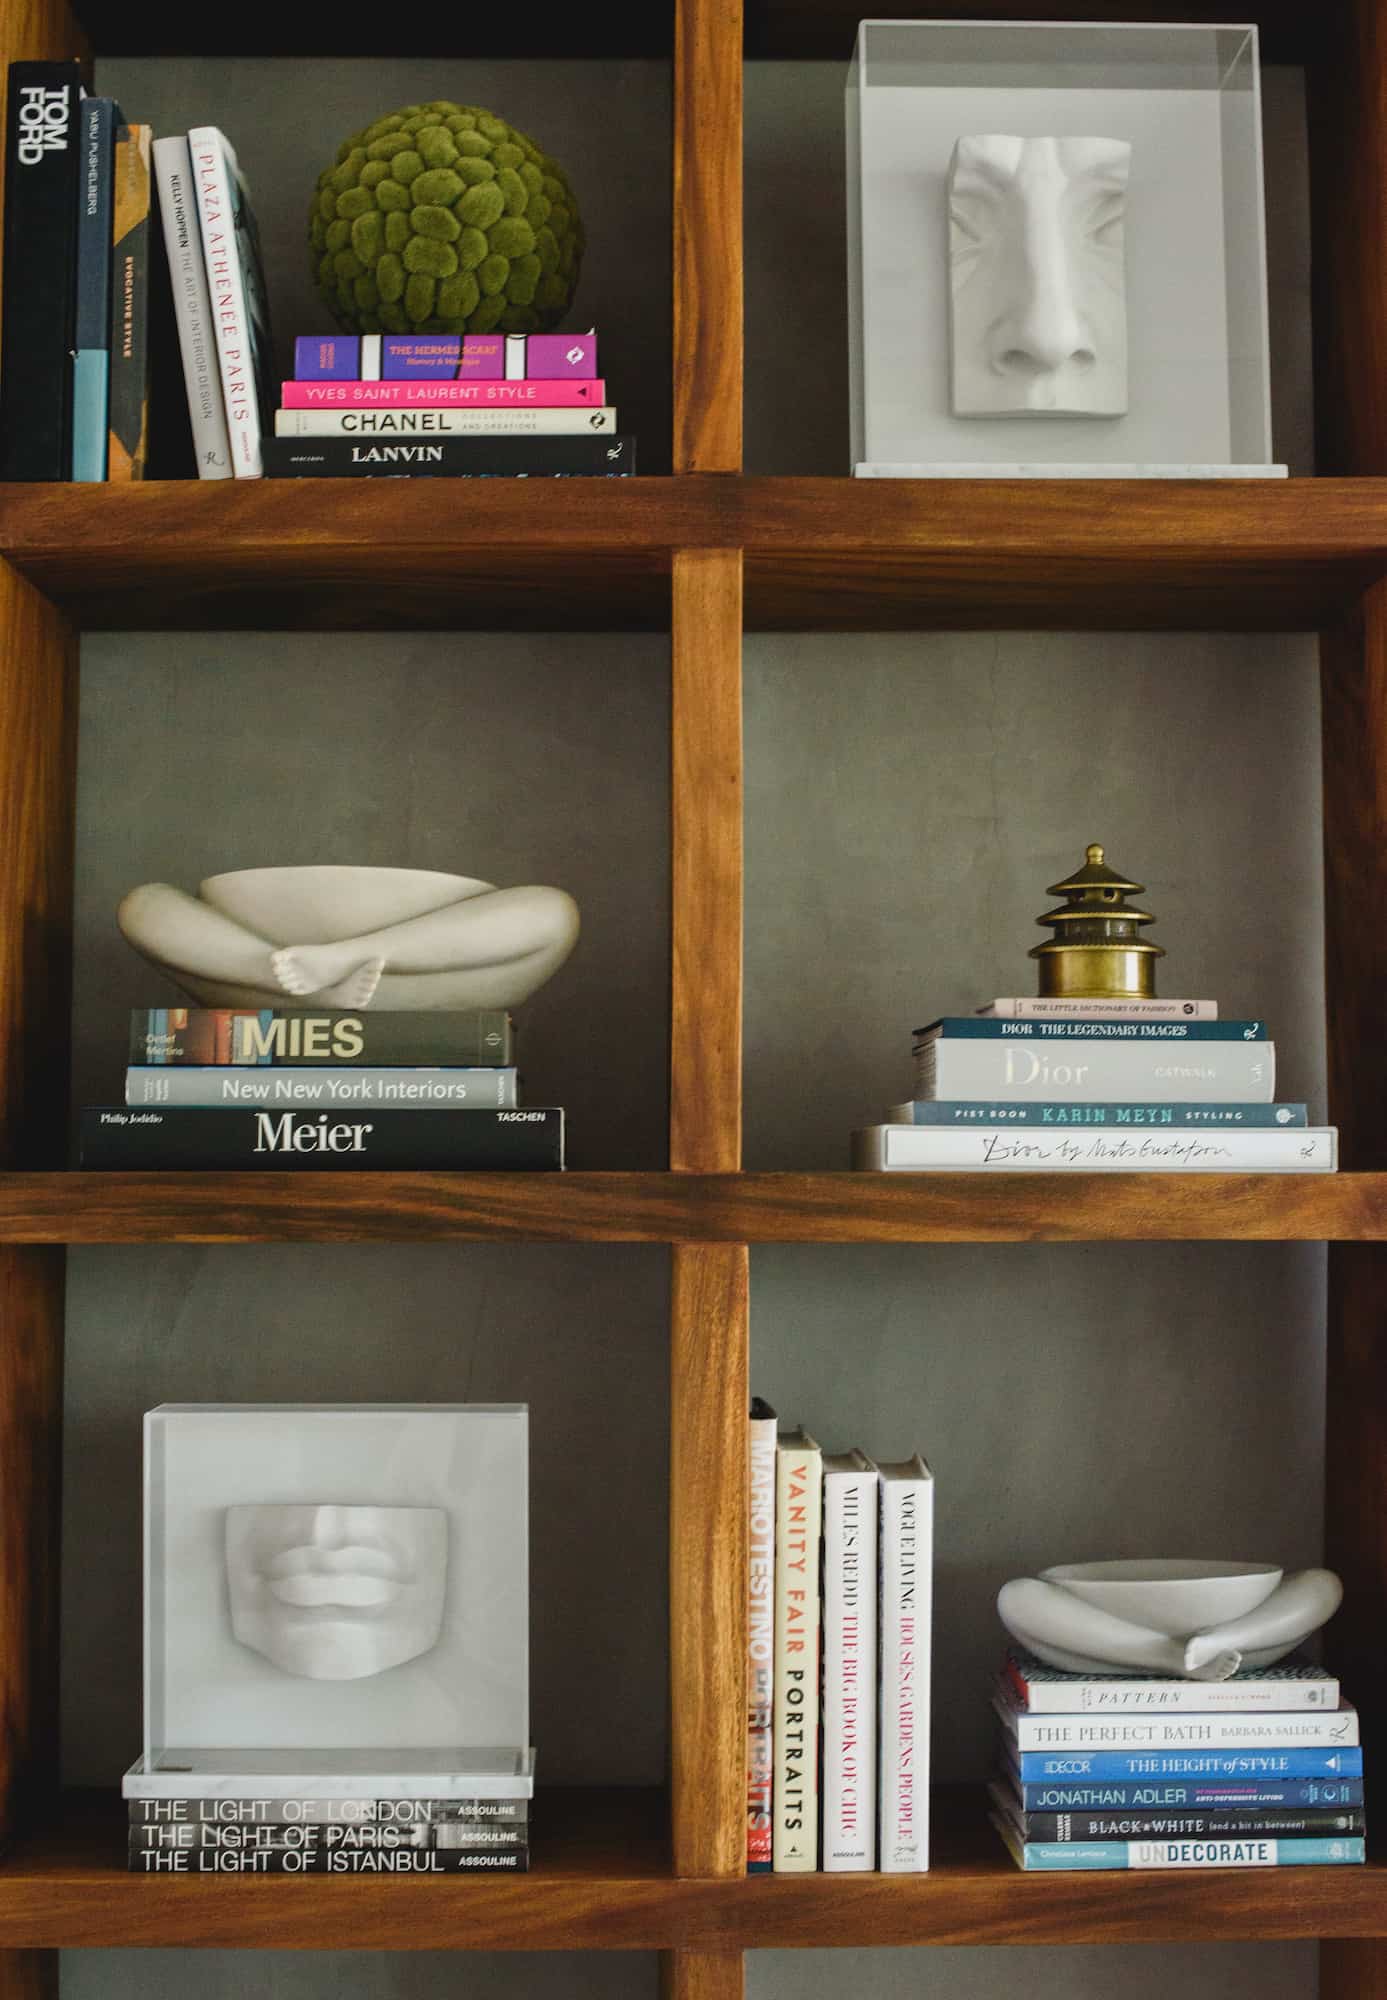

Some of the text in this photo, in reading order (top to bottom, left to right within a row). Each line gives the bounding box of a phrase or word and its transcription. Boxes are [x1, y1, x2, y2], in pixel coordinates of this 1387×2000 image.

[18, 86, 46, 165] FORD
[44, 84, 70, 151] TOM
[87, 109, 100, 216] YABU PUSHELBERG
[170, 174, 184, 204] KELLY
[175, 206, 190, 249] HOPPEN
[199, 153, 222, 223] PLAZA
[225, 348, 250, 422] PARIS
[122, 256, 134, 358] EVOCATIVE STYLE
[191, 317, 208, 376] INTERIOR
[389, 345, 412, 355] THE
[198, 375, 214, 420] DESIGN
[305, 387, 538, 400] YVES SAINT LAURENT STYLE
[341, 413, 453, 432] CHANEL
[352, 446, 444, 463] LANVIN
[243, 1017, 364, 1059] MIES
[1001, 1023, 1188, 1037] DIOR THE LEGENDARY IMAGES
[1004, 1047, 1089, 1085] Dior
[1153, 1065, 1216, 1079] CATWALK
[222, 1078, 467, 1099] New New York Interiors
[100, 1113, 129, 1125] Philip
[496, 1112, 546, 1122] TASCHEN
[955, 1108, 1244, 1123] PIET BOON KARIN MEYN STYLING
[253, 1112, 373, 1153] Meier
[983, 1135, 1052, 1163] Dior
[842, 1487, 859, 1546] MILES
[900, 1492, 916, 1548] VOGUE
[842, 1551, 858, 1607] REDD
[900, 1551, 915, 1609] LIVING
[747, 1439, 771, 1831] MARIO TESTINO PORTRAITS
[784, 1465, 806, 1830] VANITY FAIR PORTRAITS
[841, 1612, 858, 1654] THE
[841, 1659, 858, 1692] BIG
[1098, 1691, 1181, 1704] PATTERN
[841, 1697, 857, 1753] BOOK
[1034, 1725, 1321, 1742] THE PERFECT BATH BARBARA SALLICK
[841, 1756, 857, 1783] OF
[1127, 1759, 1159, 1773] THE
[1162, 1759, 1222, 1773] HEIGHT
[1223, 1758, 1239, 1774] of
[1240, 1757, 1289, 1771] STYLE
[139, 1800, 516, 1822] THE LIGHT OF LONDON ASSOULINE
[897, 1773, 912, 1841] PEOPLE
[1037, 1790, 1126, 1806] JONATHAN
[1132, 1788, 1187, 1805] ADLER
[840, 1787, 857, 1839] CHIC
[1089, 1821, 1142, 1834] BLACK
[1151, 1819, 1204, 1833] WHITE
[1209, 1823, 1229, 1831] (and
[1265, 1821, 1305, 1830] between)
[142, 1825, 517, 1848] THE LIGHT OF PARIS ASSOULINE
[140, 1850, 517, 1872] THE LIGHT OF ISTANBUL ASSOULINE
[1139, 1843, 1268, 1863] UNDECORATE
